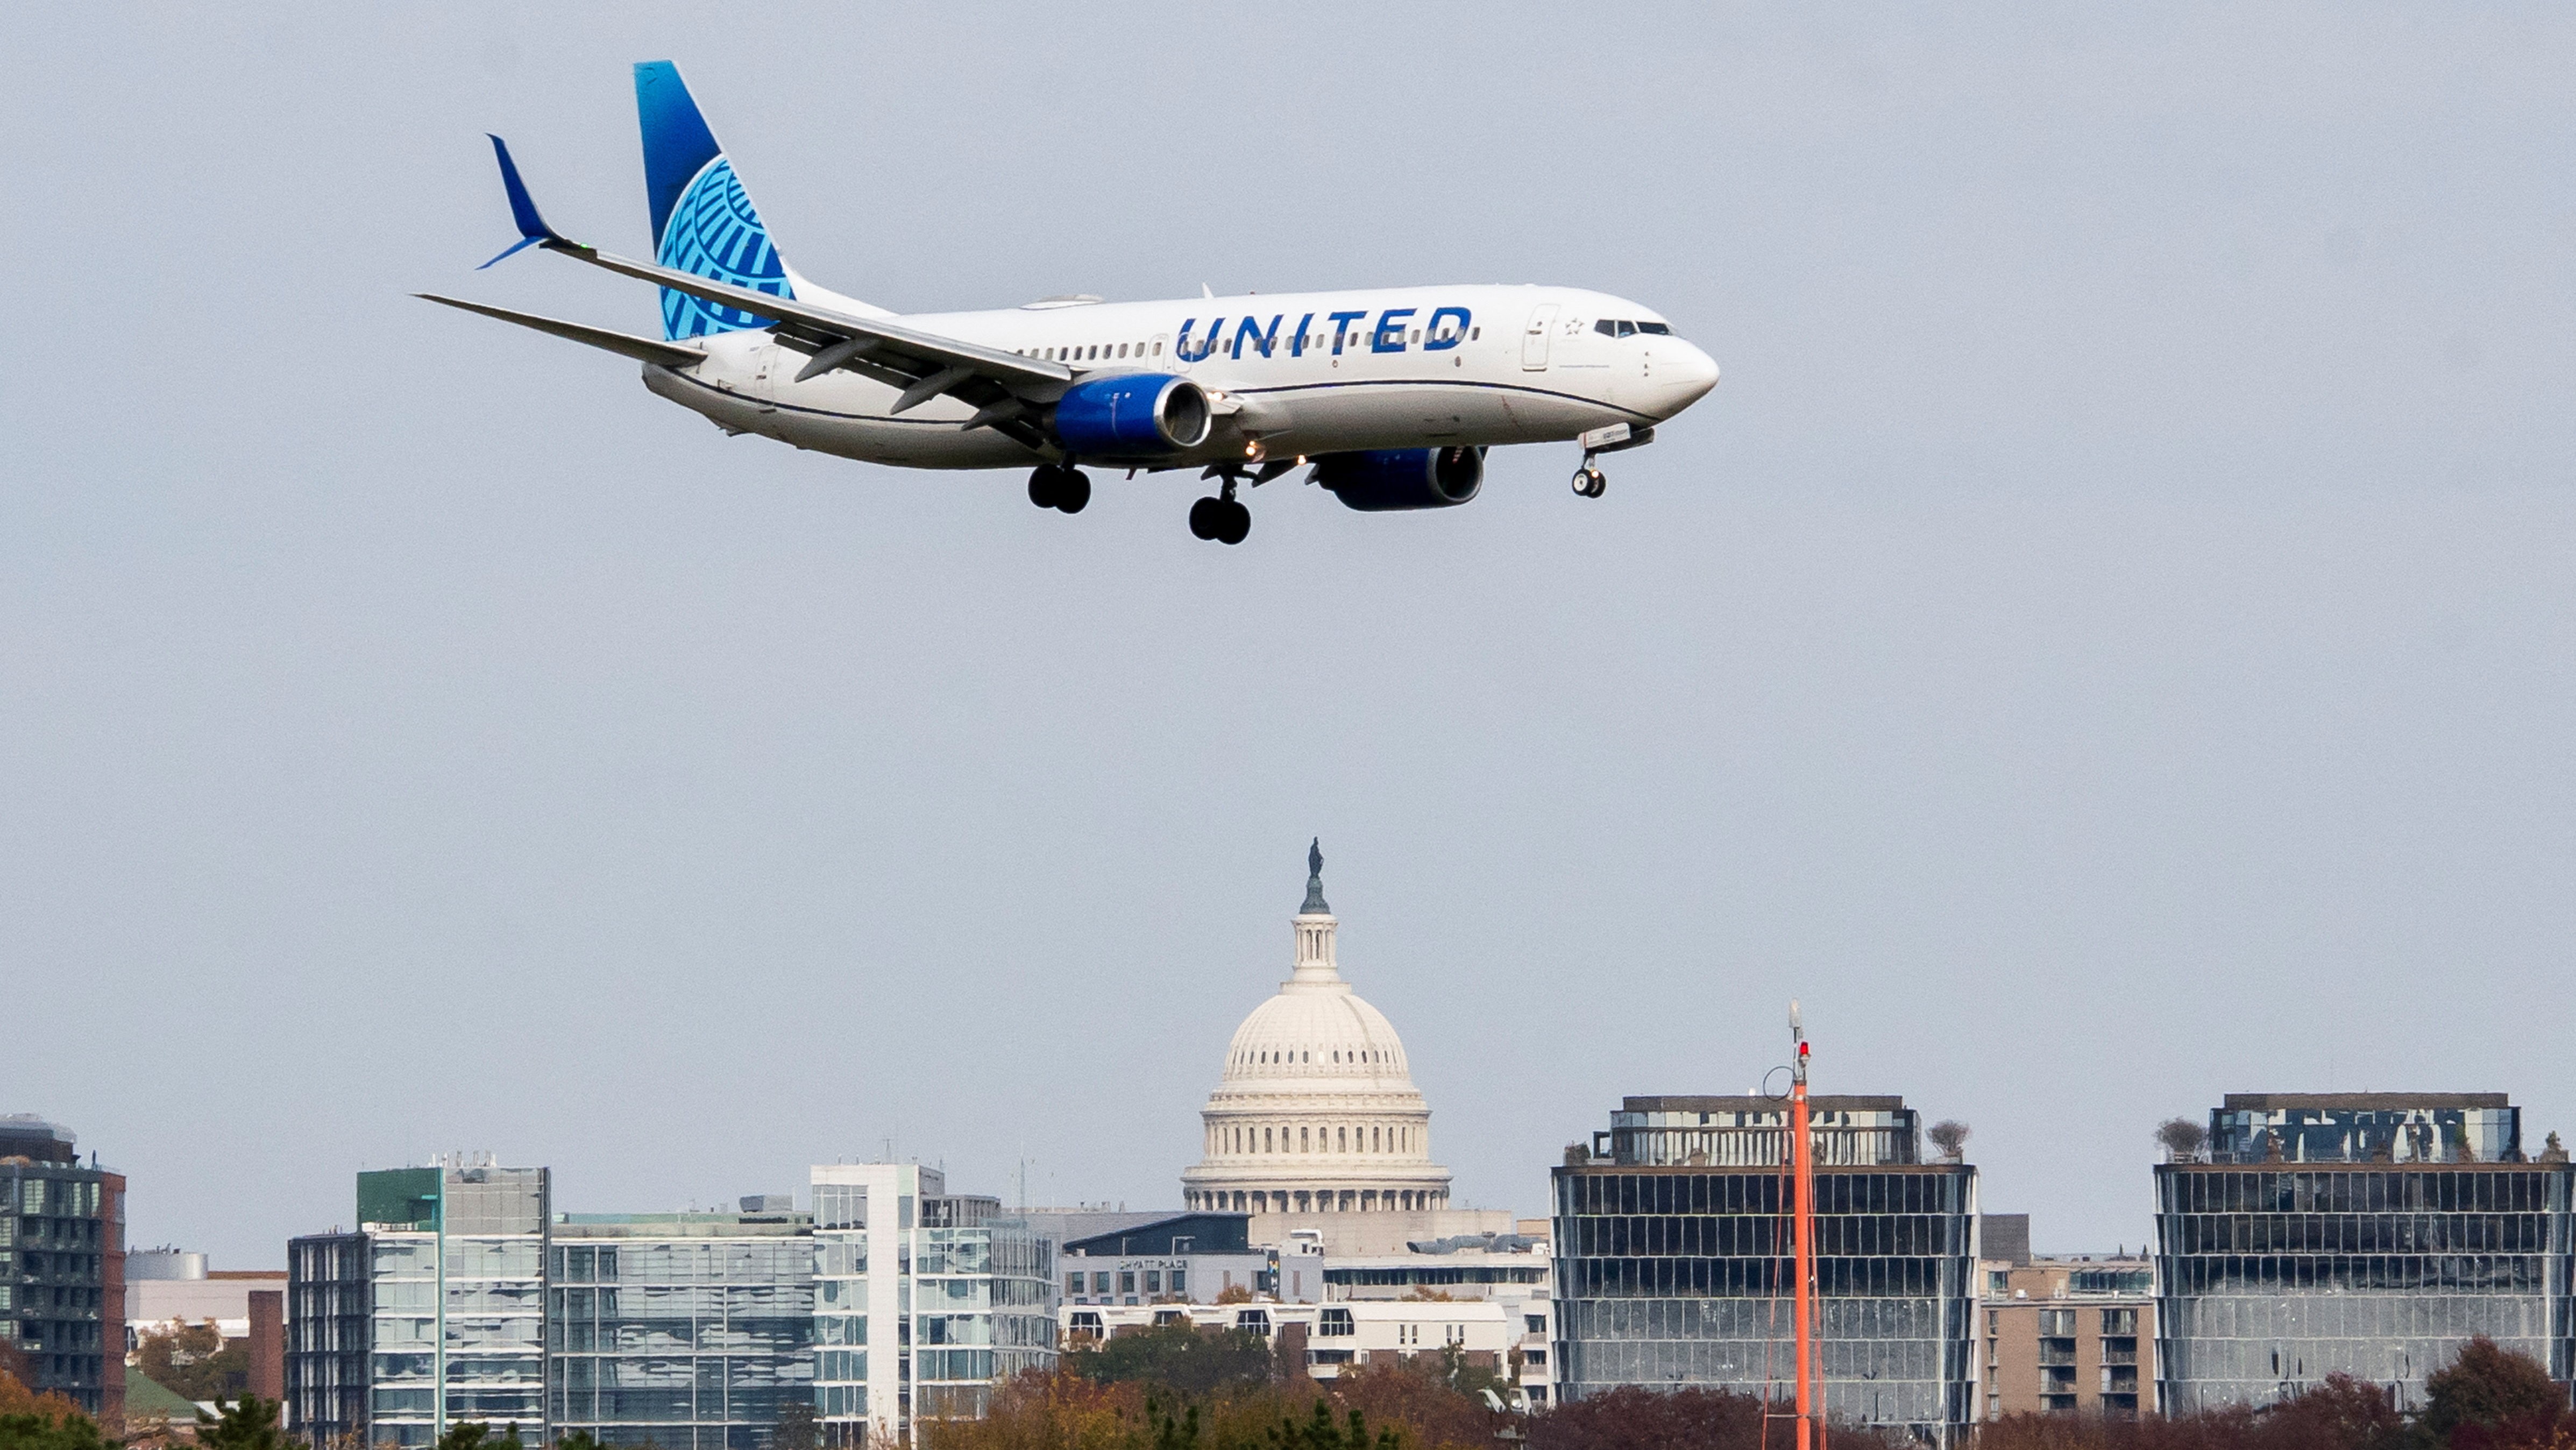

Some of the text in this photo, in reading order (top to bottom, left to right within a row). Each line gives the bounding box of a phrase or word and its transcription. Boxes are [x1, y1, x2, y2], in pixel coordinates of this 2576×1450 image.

[1176, 307, 1472, 363] UNITED
[1126, 1260, 1187, 1269] HYATT PLACE
